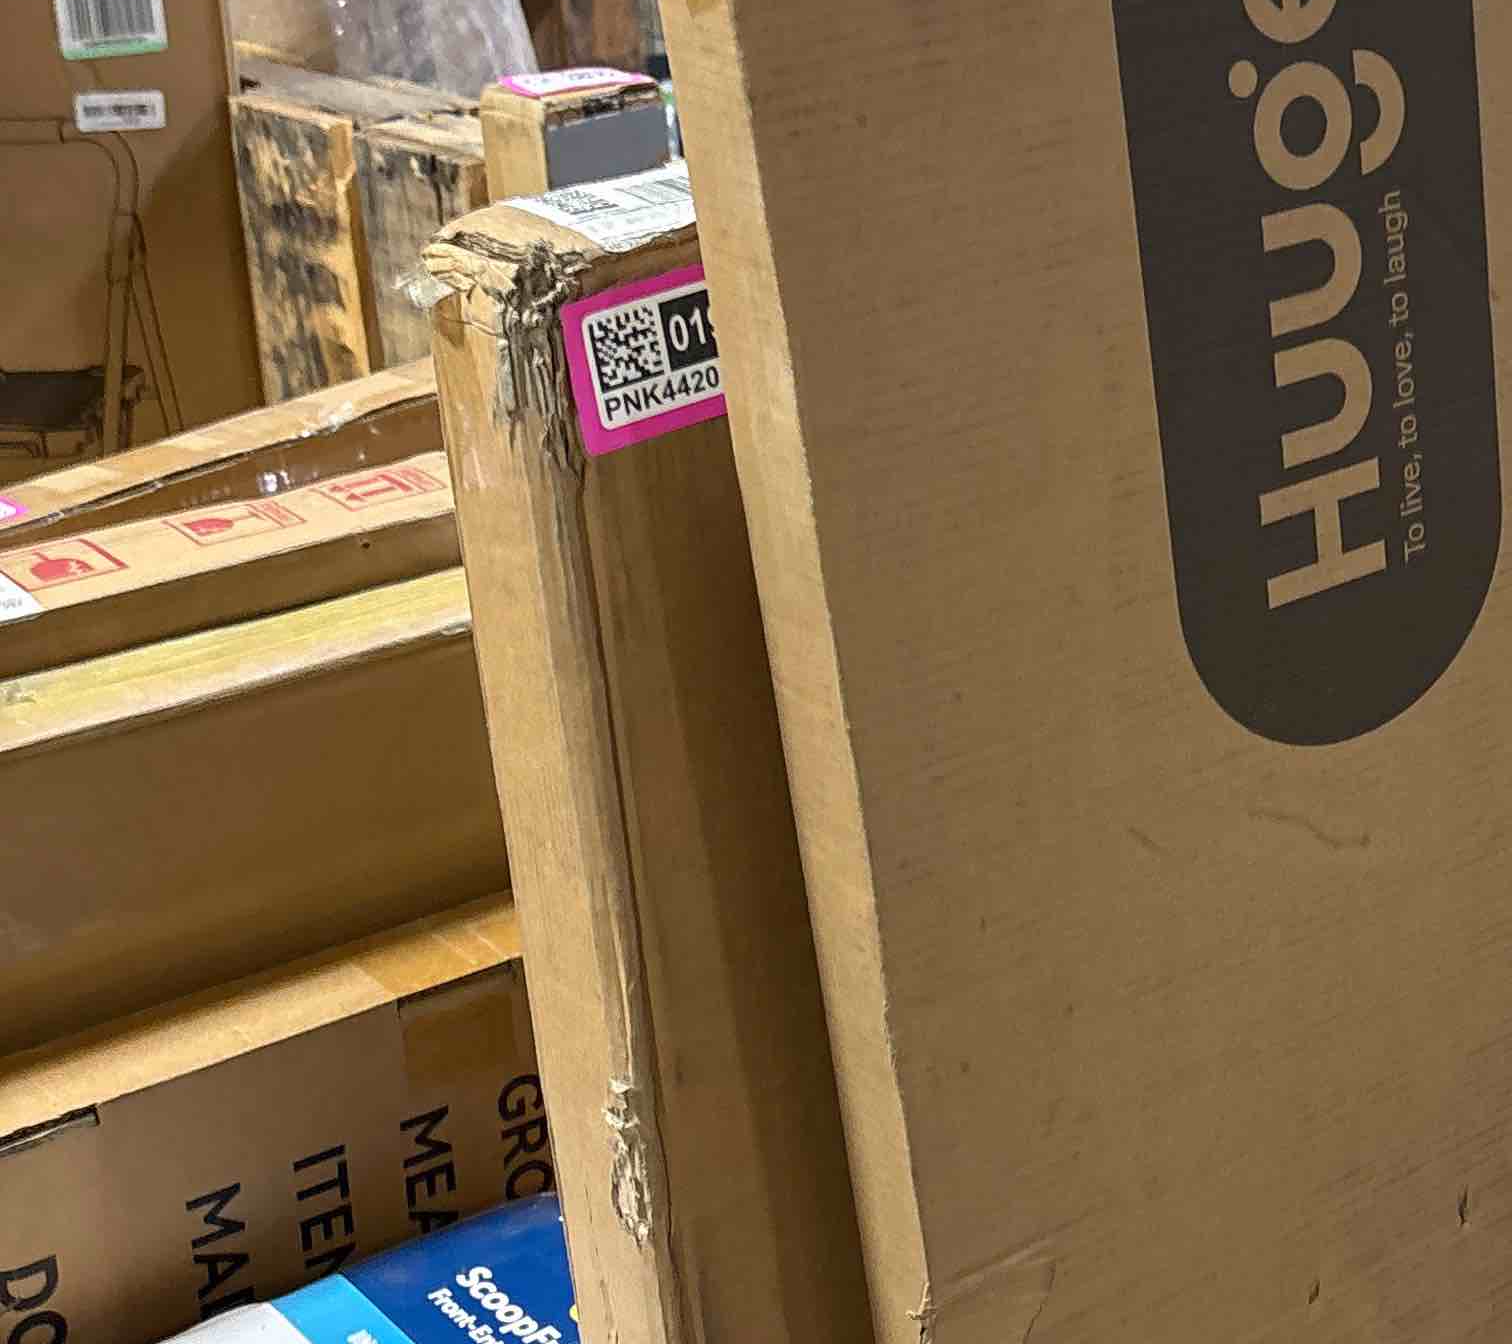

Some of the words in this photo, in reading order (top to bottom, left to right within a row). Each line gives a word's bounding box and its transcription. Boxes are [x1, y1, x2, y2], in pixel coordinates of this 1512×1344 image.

[1378, 191, 1409, 285] laugh
[668, 307, 708, 353] 01
[1388, 292, 1409, 328] to
[603, 365, 720, 422] PNK4420
[1392, 332, 1416, 408] love,
[1398, 414, 1418, 449] to
[1400, 453, 1423, 517] live,
[1403, 522, 1426, 564] To
